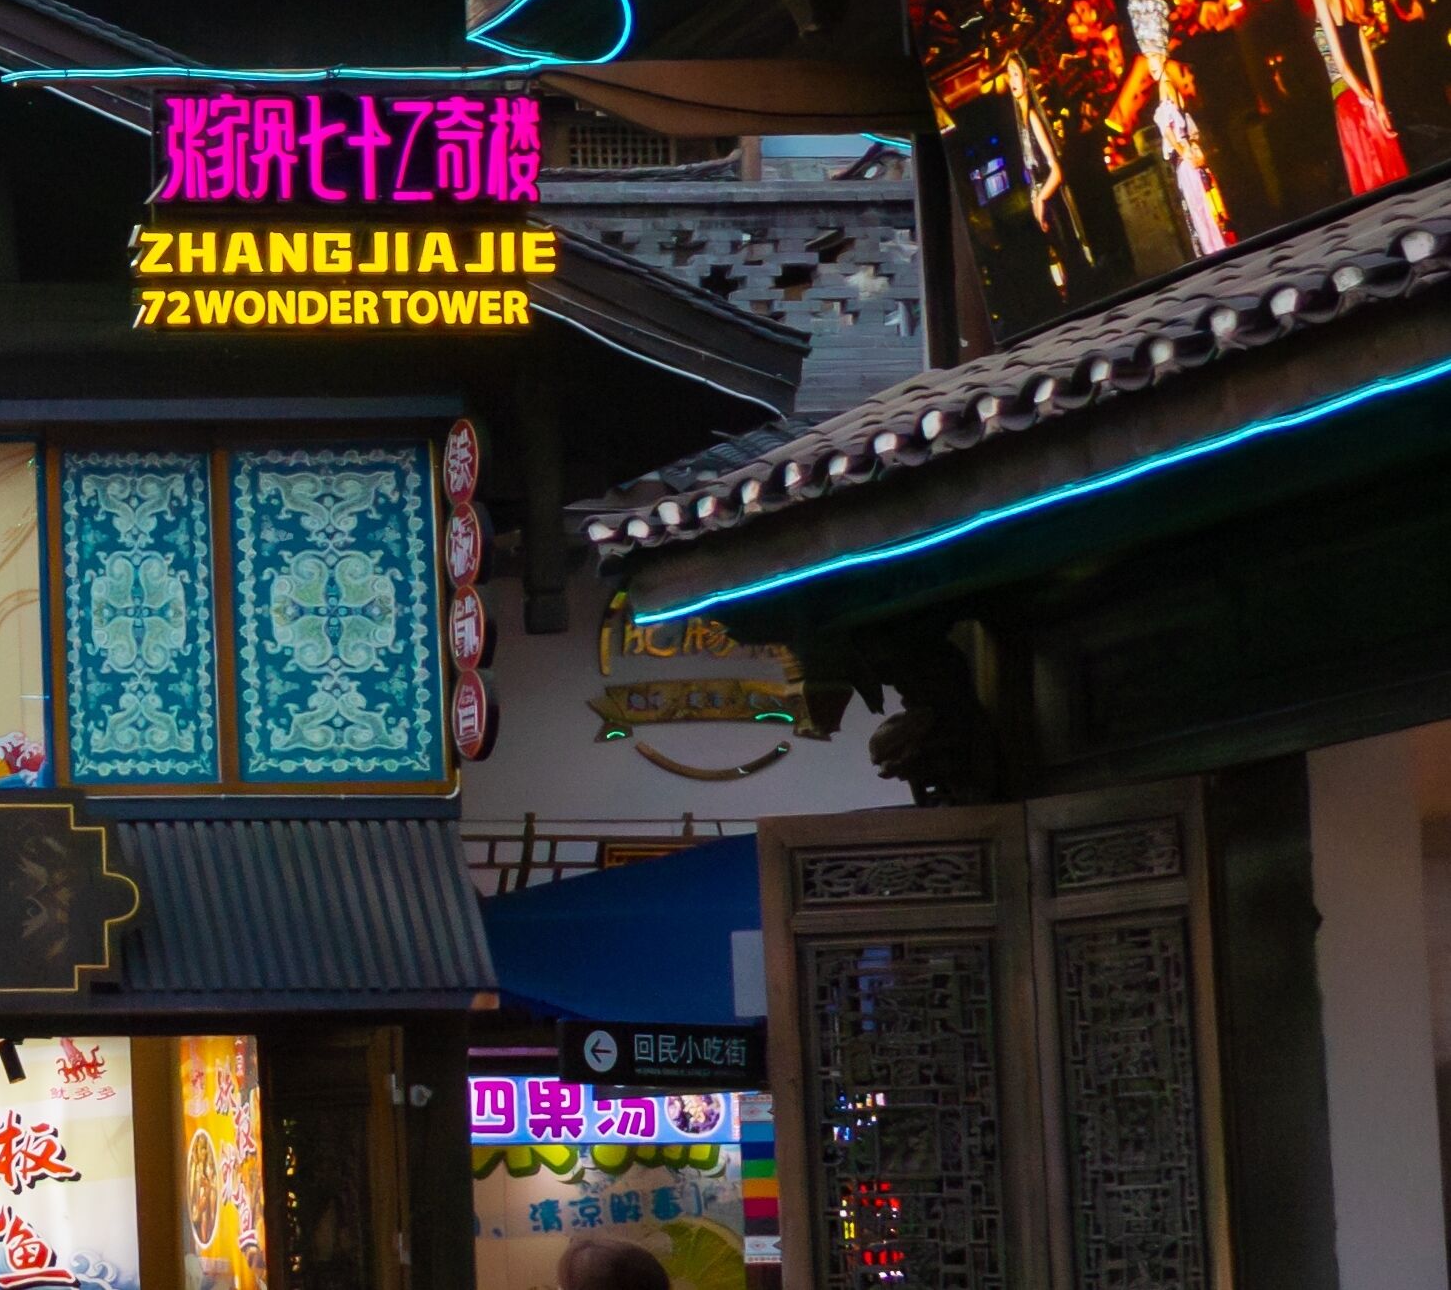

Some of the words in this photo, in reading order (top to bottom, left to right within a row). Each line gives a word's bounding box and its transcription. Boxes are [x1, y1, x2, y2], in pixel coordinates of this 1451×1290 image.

[139, 230, 557, 274] ZHANGJIAJIE
[141, 290, 191, 325] 72
[194, 290, 380, 325] WONDER
[382, 290, 530, 325] TOWER
[634, 1033, 747, 1067] 回民小吃街
[49, 1085, 117, 1101] 鱿多多
[470, 1079, 657, 1139] 四果汤
